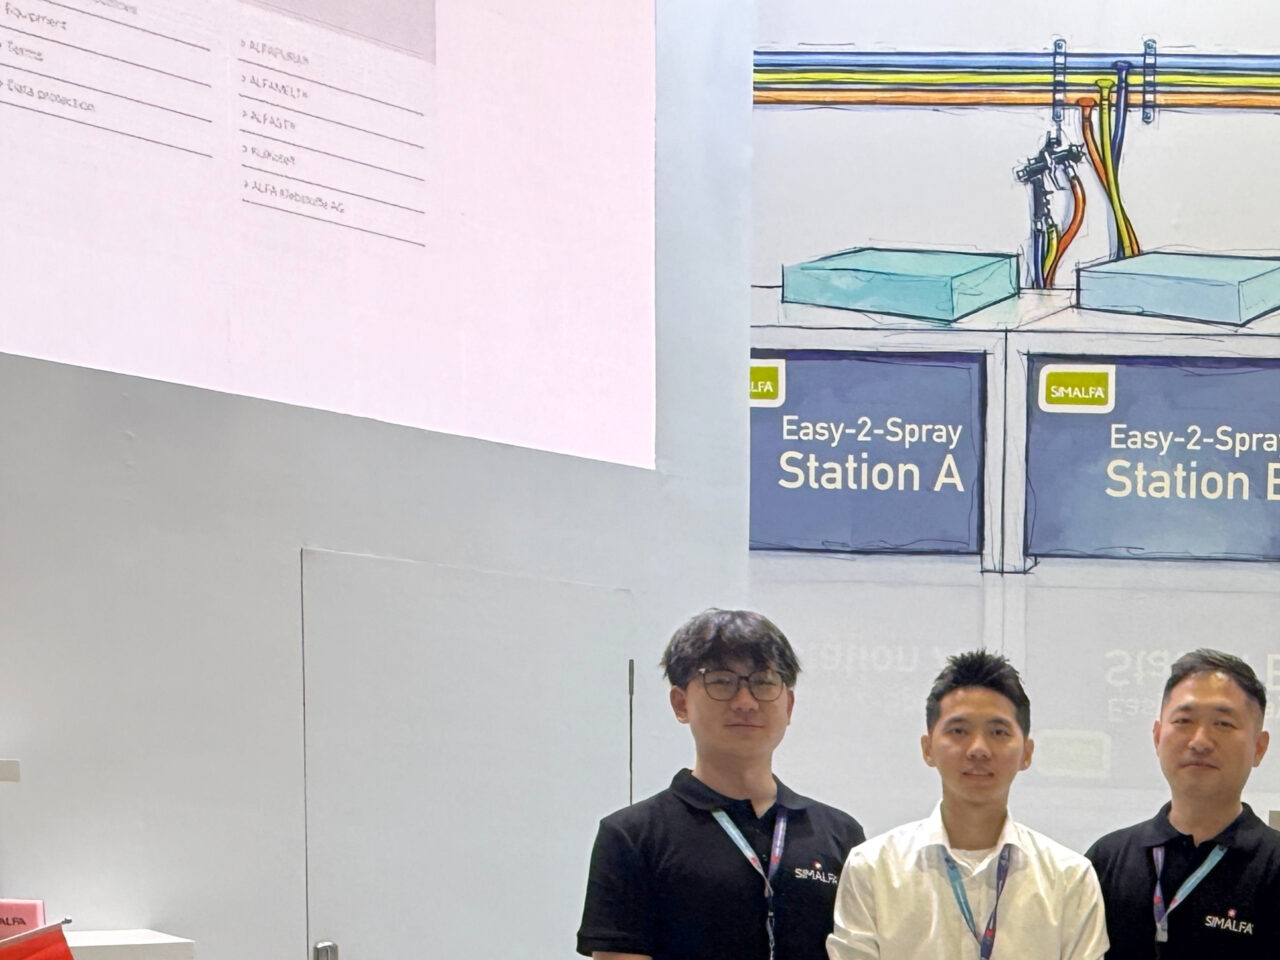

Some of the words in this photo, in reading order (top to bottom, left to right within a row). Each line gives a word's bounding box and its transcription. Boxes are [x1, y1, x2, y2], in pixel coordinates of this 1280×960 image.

[749, 381, 774, 393] LFA
[1050, 386, 1105, 399] SIMALFA
[782, 415, 963, 450] Easy-2-Spray
[778, 451, 920, 491] Station
[933, 453, 965, 492] A
[1105, 459, 1250, 500] Station
[1205, 915, 1254, 935] SIMALFA
